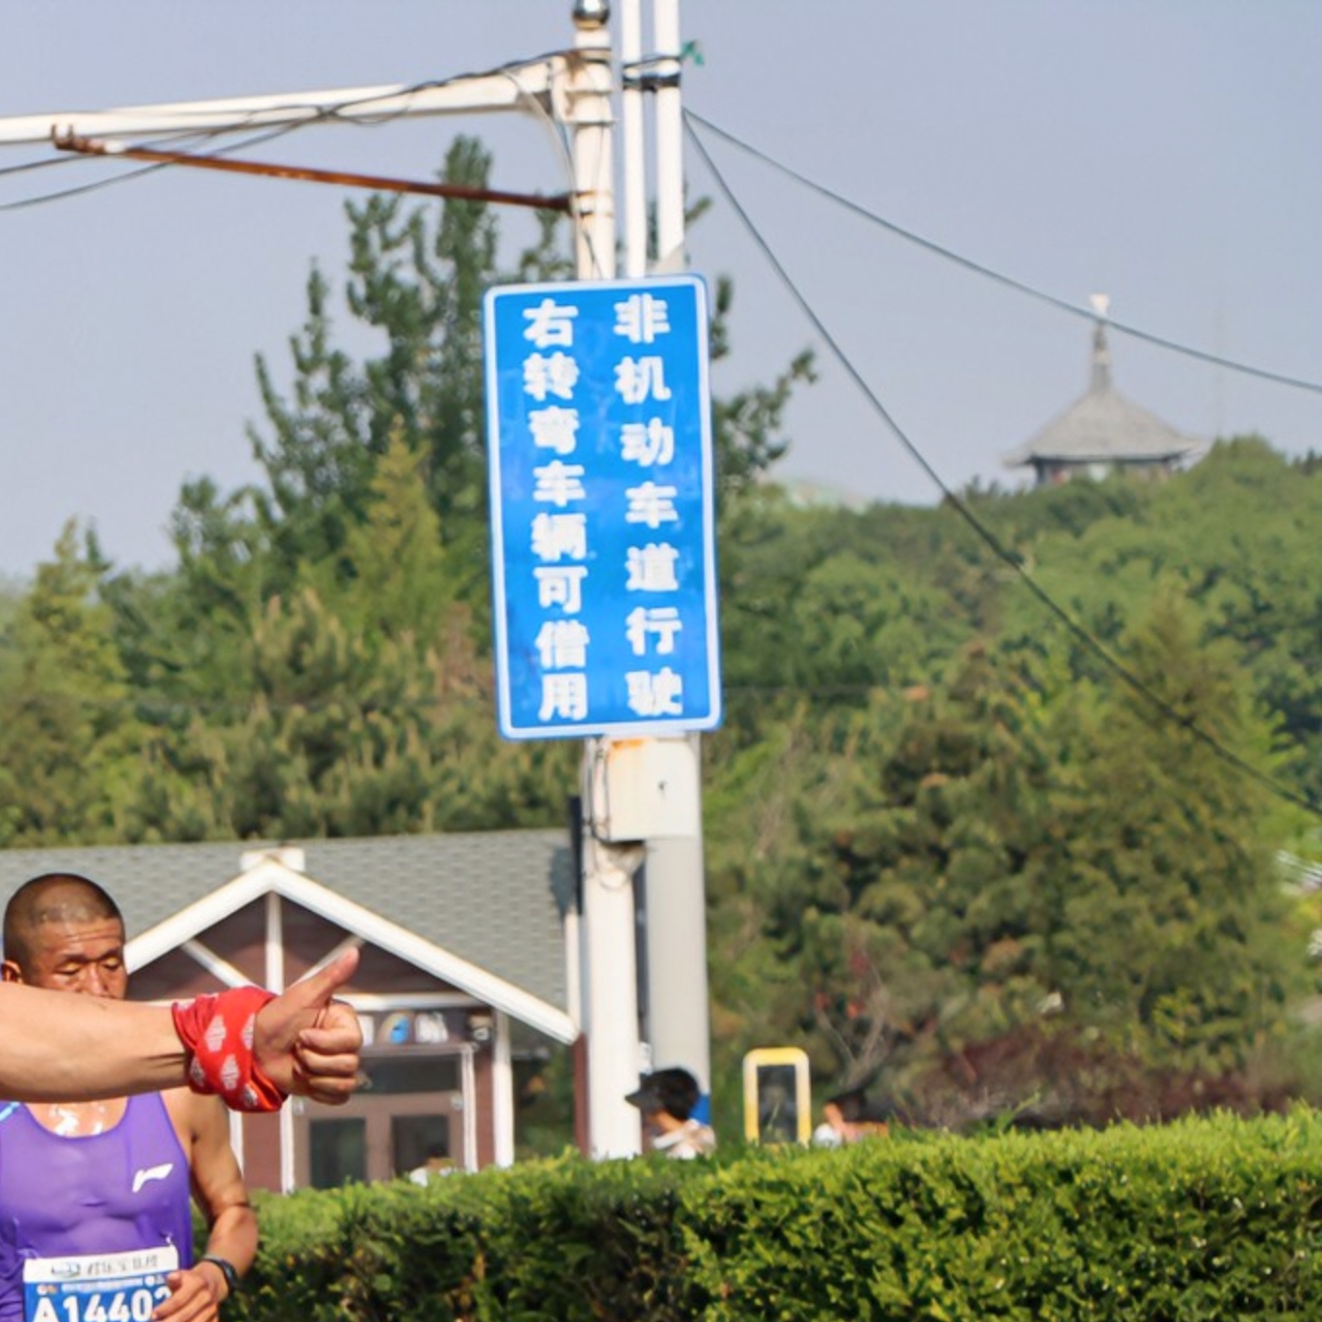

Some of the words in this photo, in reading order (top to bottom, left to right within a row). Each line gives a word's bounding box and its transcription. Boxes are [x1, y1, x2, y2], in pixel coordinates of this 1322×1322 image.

[613, 293, 683, 716] 非机动车道行驶
